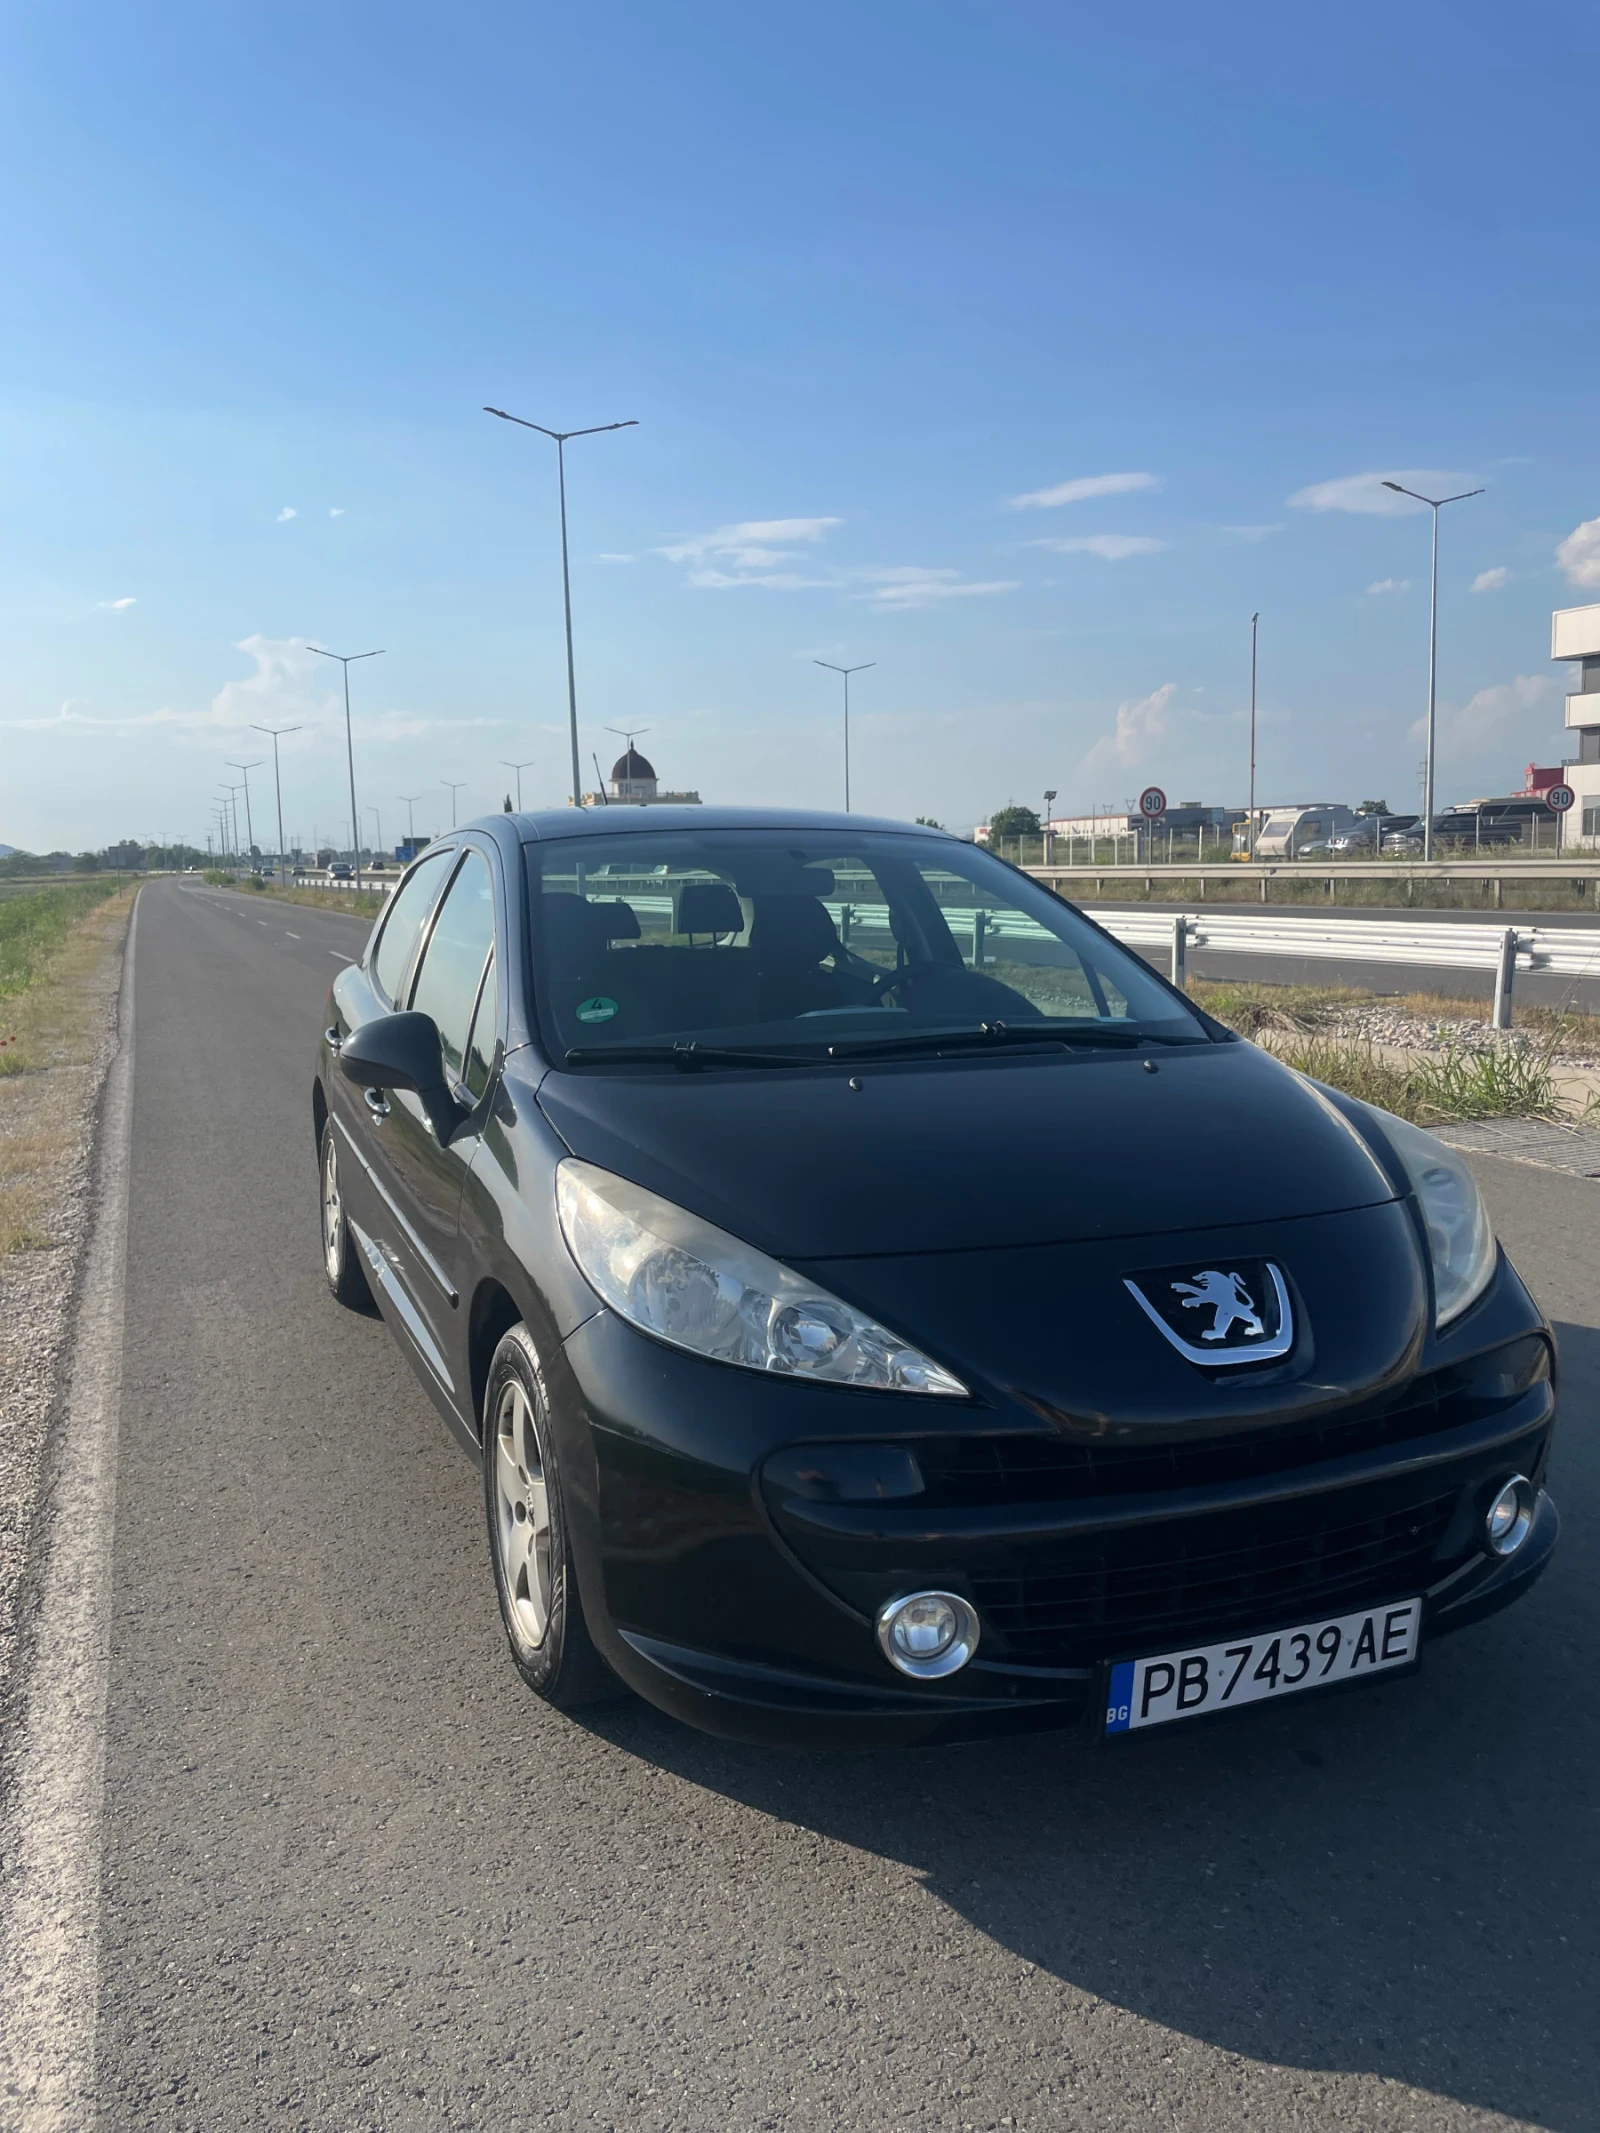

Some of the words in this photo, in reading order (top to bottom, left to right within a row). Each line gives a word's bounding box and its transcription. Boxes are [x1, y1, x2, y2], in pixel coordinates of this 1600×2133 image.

[1145, 795, 1161, 811] 90
[1552, 791, 1569, 805] 90
[591, 999, 603, 1010] 4
[1140, 1655, 1209, 1719] PB
[1220, 1624, 1342, 1701] 7439
[1350, 1606, 1413, 1669] AE
[1106, 1705, 1128, 1724] BG
